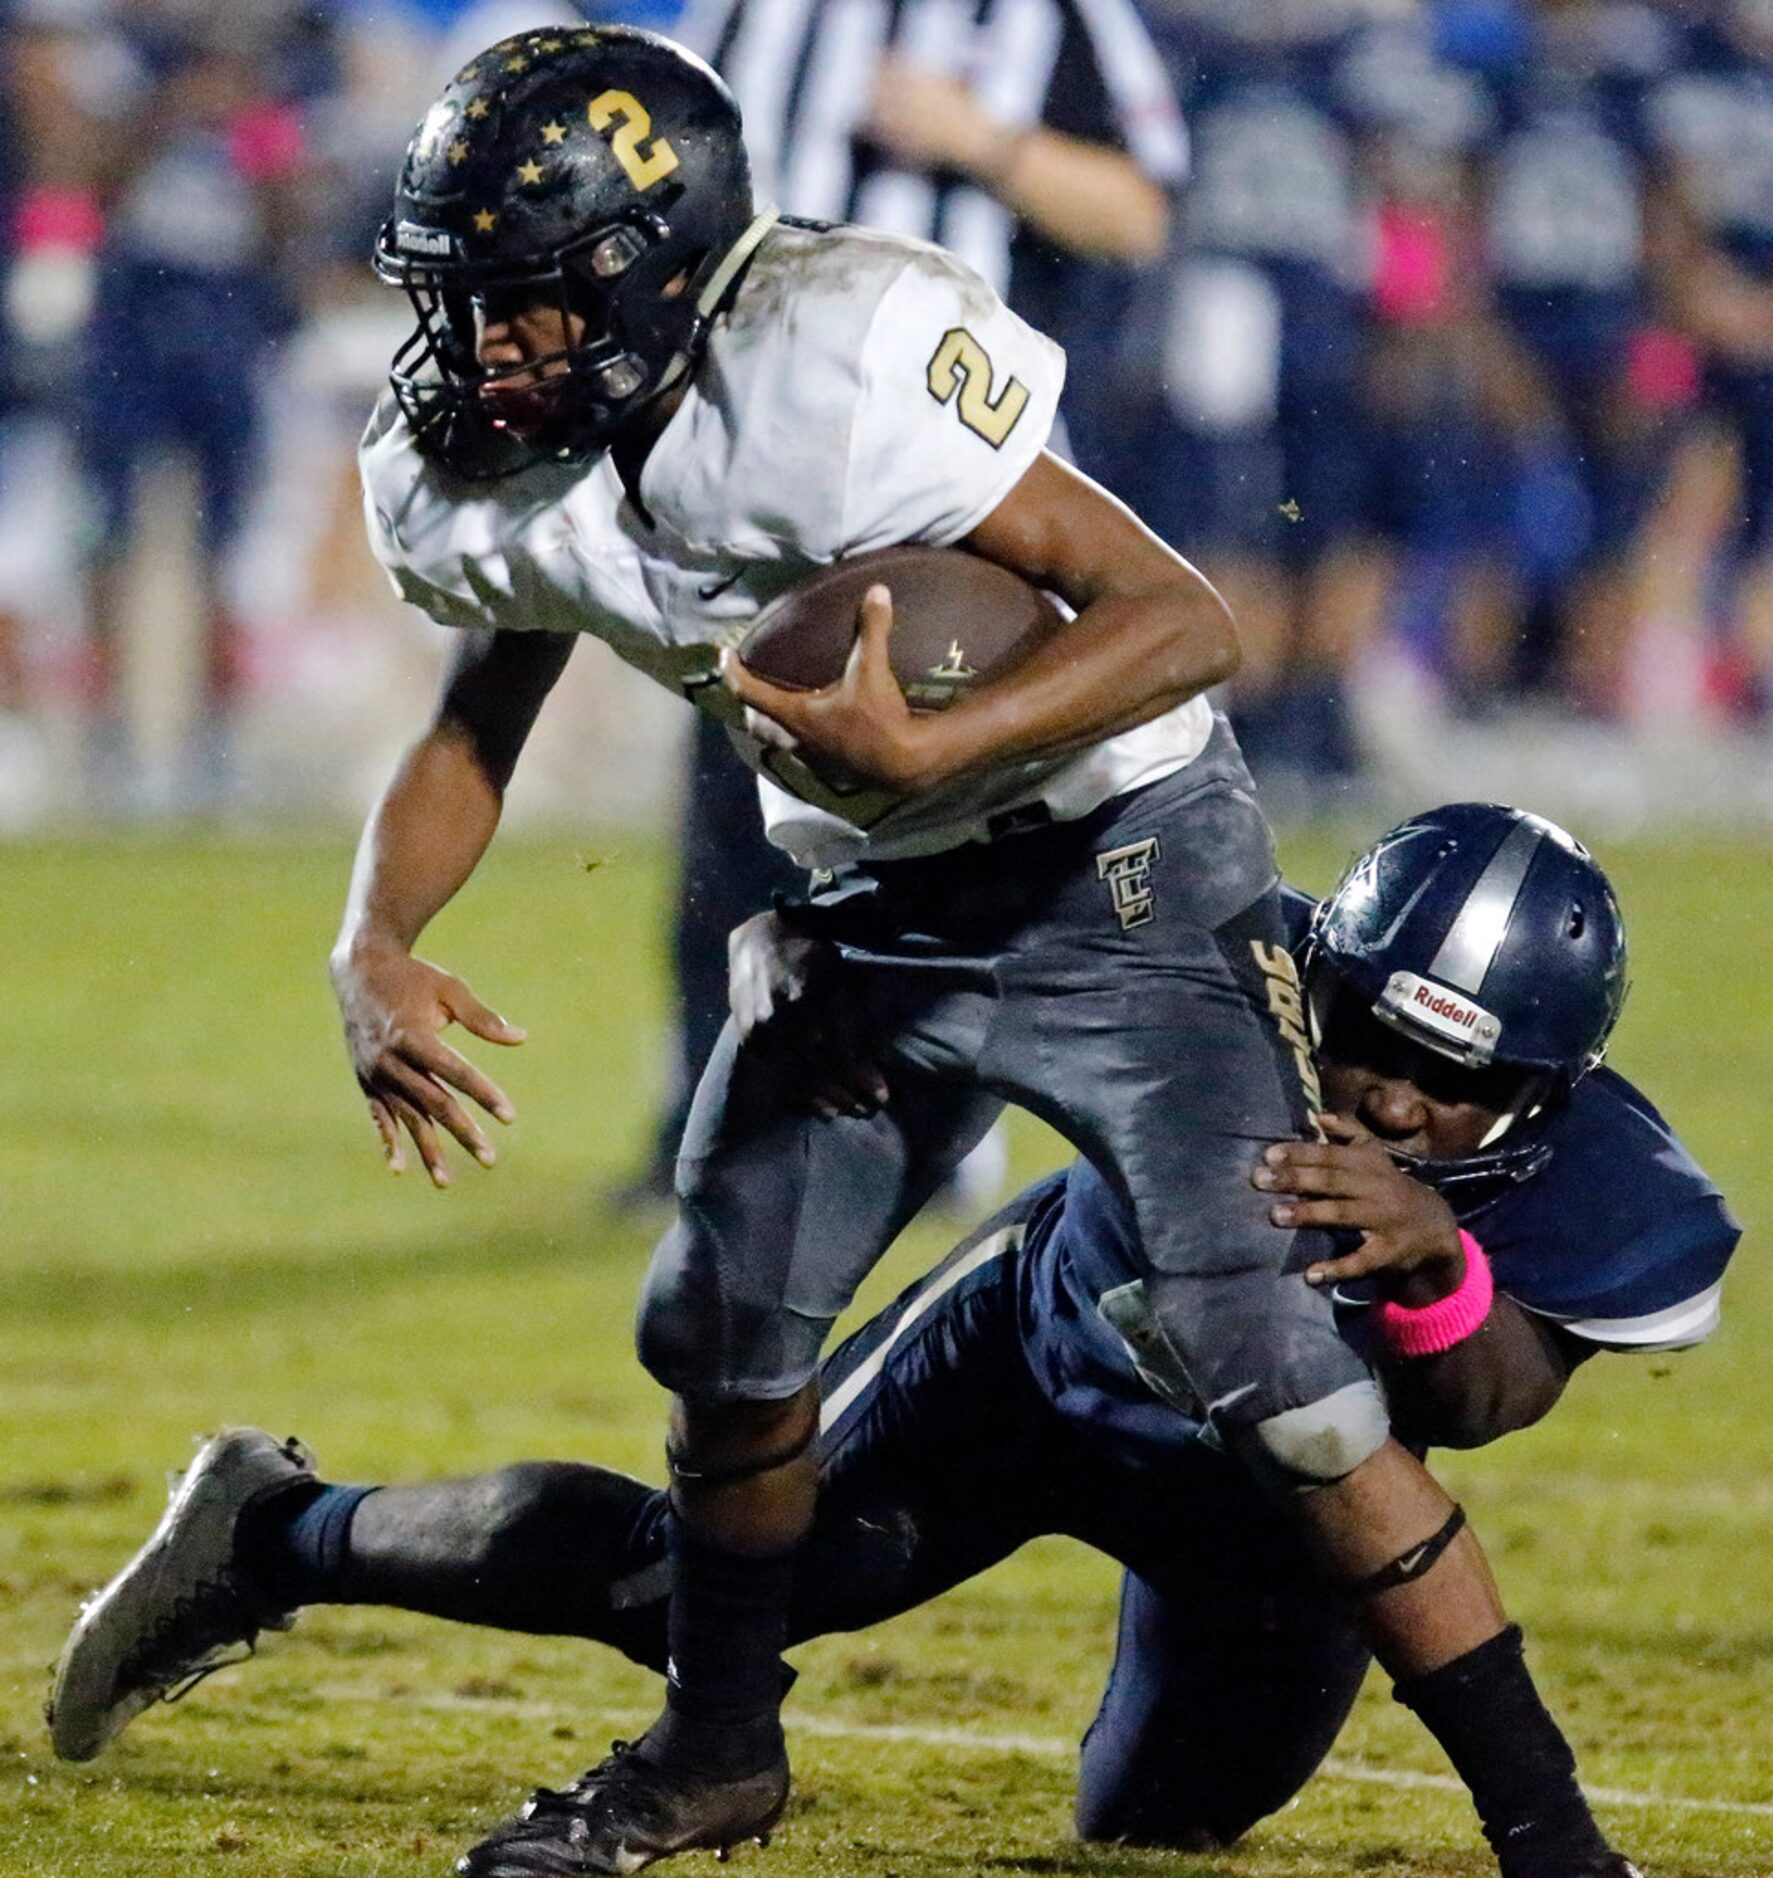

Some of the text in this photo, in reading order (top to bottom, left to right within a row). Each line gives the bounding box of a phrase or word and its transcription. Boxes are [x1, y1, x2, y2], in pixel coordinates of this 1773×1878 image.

[588, 89, 679, 191] 2
[926, 321, 1031, 451] 2
[1413, 985, 1478, 1028] Riddell
